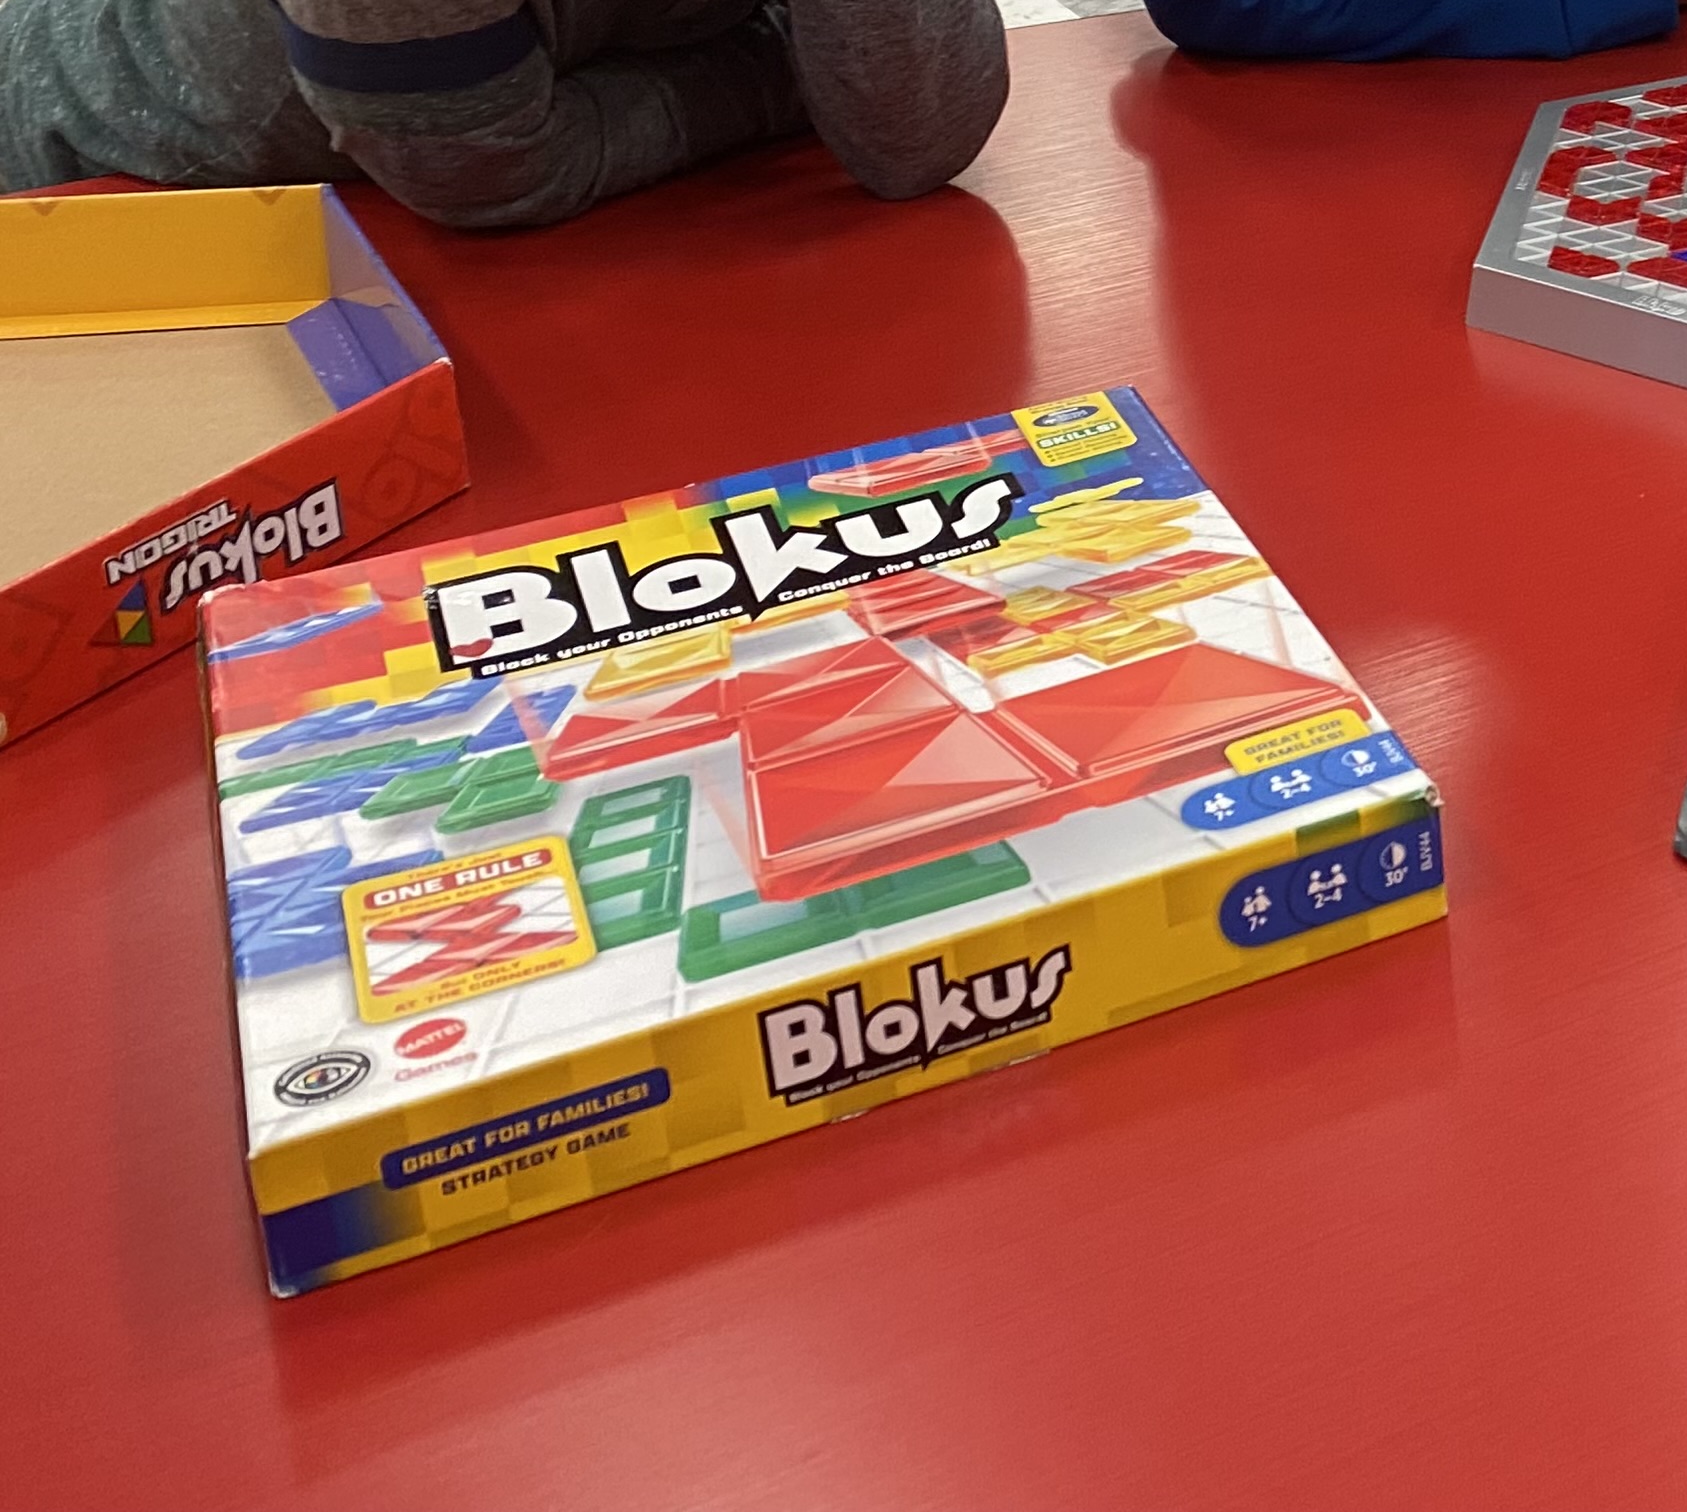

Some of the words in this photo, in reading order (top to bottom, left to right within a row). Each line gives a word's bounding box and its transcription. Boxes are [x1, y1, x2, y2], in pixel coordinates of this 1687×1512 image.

[1038, 420, 1118, 448] SKILLS!
[103, 498, 238, 585] TRIGON
[162, 478, 345, 614] Blokus
[434, 476, 1014, 667] Blokus
[480, 652, 550, 676] Block
[556, 637, 611, 659] your
[617, 605, 744, 642] Opponents
[778, 571, 872, 602] Conquer
[877, 560, 914, 576] the
[918, 538, 992, 565] Board!
[1244, 730, 1301, 756] GREAT
[1306, 718, 1343, 735] FOR
[1255, 730, 1345, 764] FAMILIES!
[373, 877, 446, 907] ONE
[455, 851, 543, 886] RULE
[1248, 915, 1268, 932] 7+
[394, 999, 418, 1013] AT
[425, 988, 462, 1004] THE
[468, 958, 566, 992] CORNERS!
[472, 961, 521, 980] ONLY
[394, 1021, 466, 1055] MATTEL
[764, 949, 1067, 1092] Blokus
[394, 1051, 479, 1083] Games
[402, 1137, 477, 1175] GREAT
[484, 1119, 531, 1148] FOR
[536, 1082, 650, 1131] FAMILIES!
[441, 1144, 559, 1196] STRATEGY
[566, 1122, 632, 1155] GAME
